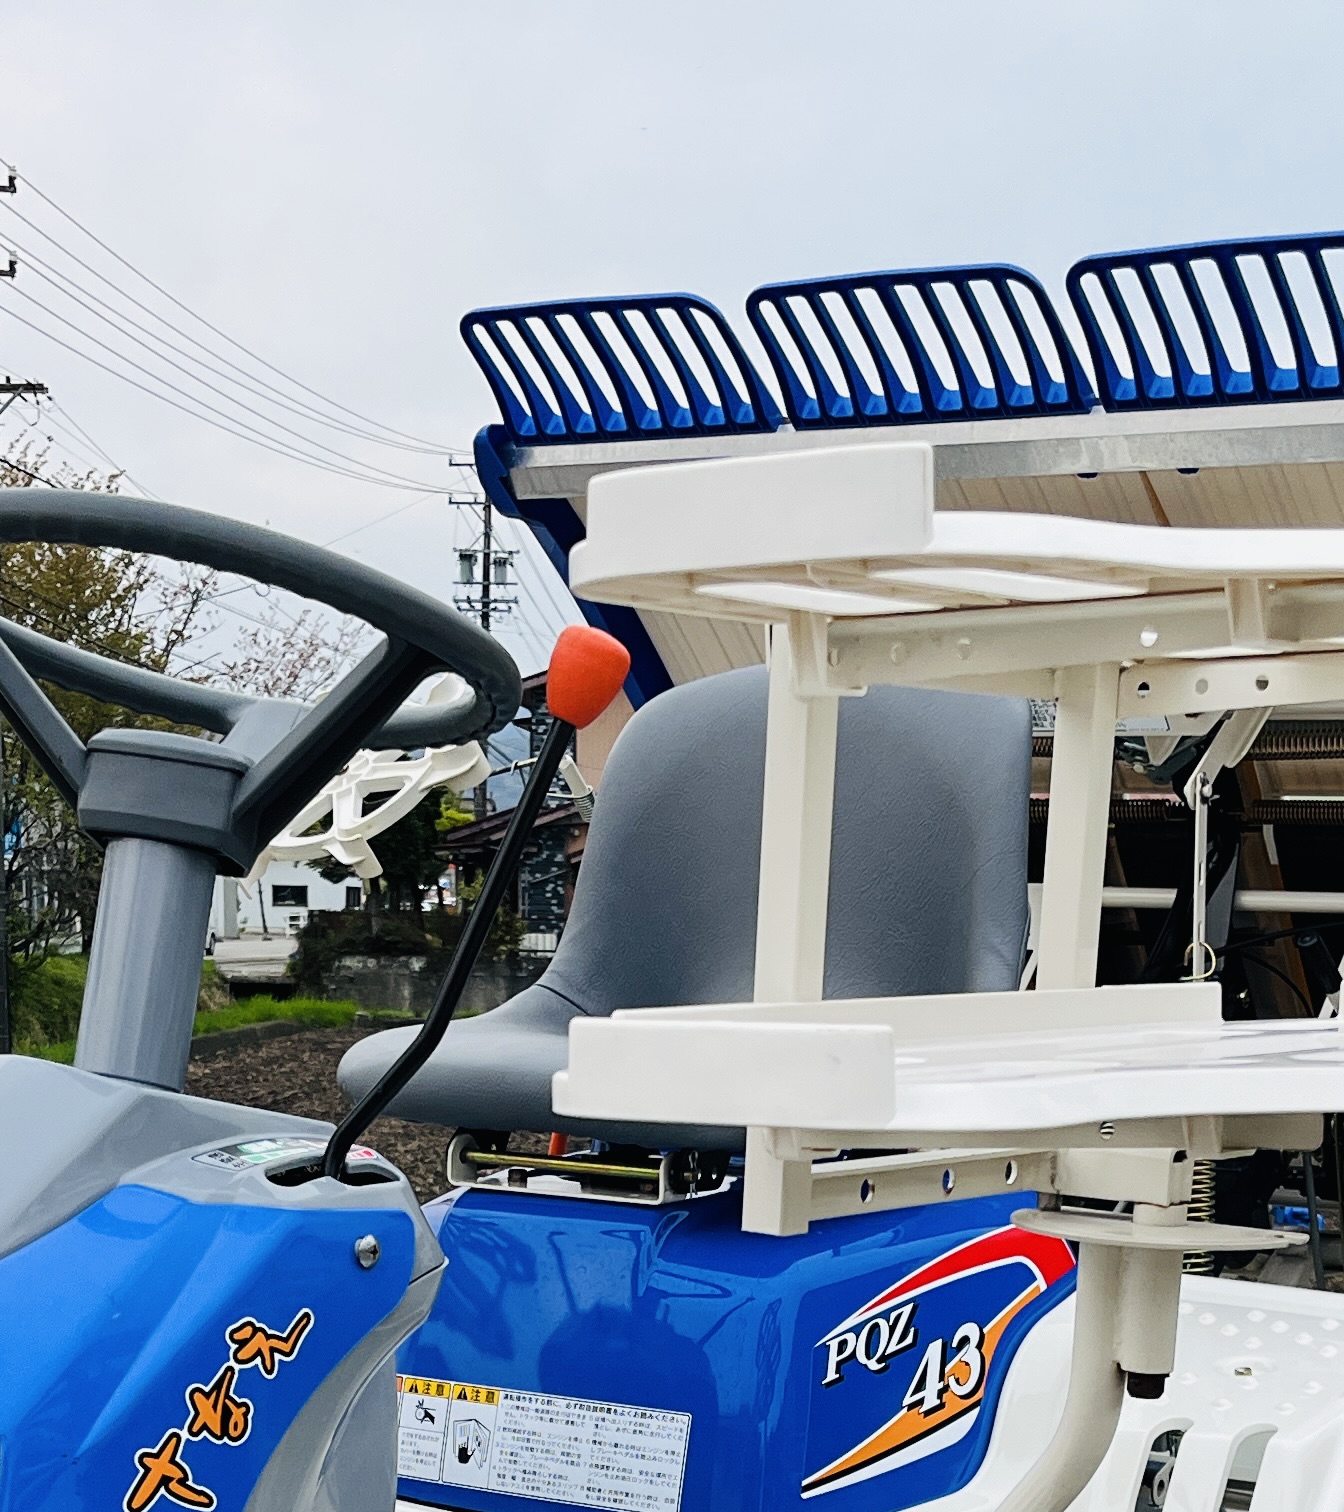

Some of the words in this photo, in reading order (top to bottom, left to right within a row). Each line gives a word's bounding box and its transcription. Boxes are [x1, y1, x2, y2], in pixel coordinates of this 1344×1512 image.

[821, 1302, 919, 1389] PQZ
[902, 1322, 985, 1417] 43
[422, 1382, 444, 1396] 注意
[470, 1388, 494, 1403] 注意
